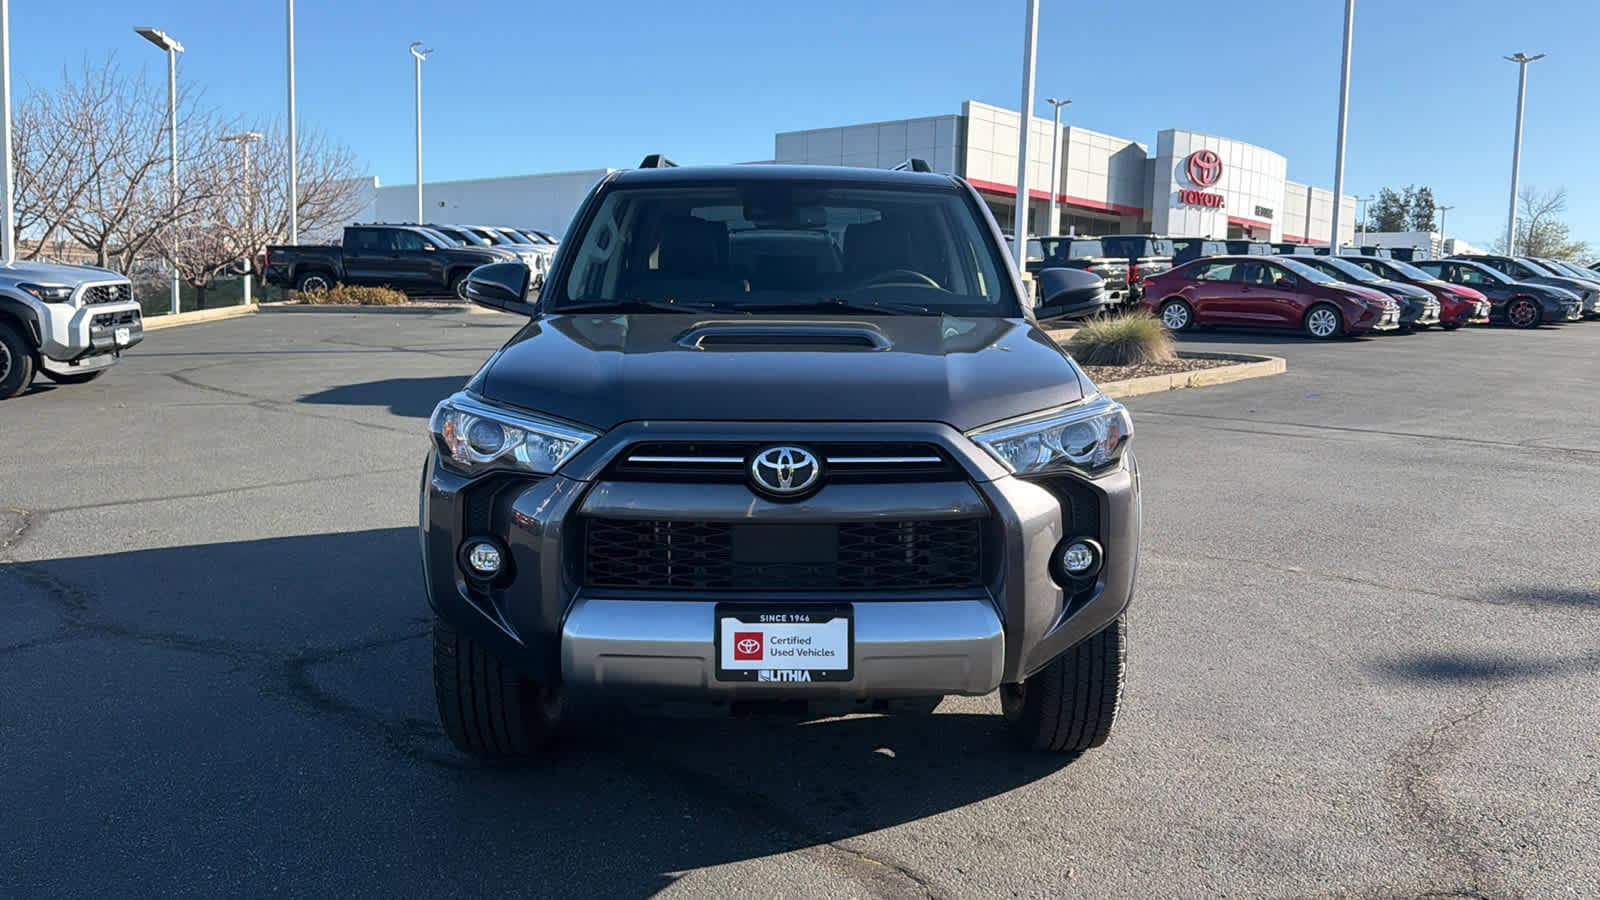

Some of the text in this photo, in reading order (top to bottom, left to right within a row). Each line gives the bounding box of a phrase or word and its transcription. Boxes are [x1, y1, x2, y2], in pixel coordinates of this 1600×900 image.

[1179, 190, 1225, 208] TOYOTA
[760, 614, 810, 622] SINCE 1946
[770, 636, 811, 645] Certified
[770, 649, 835, 657] Used Vehicles
[770, 670, 811, 682] LITHIA
